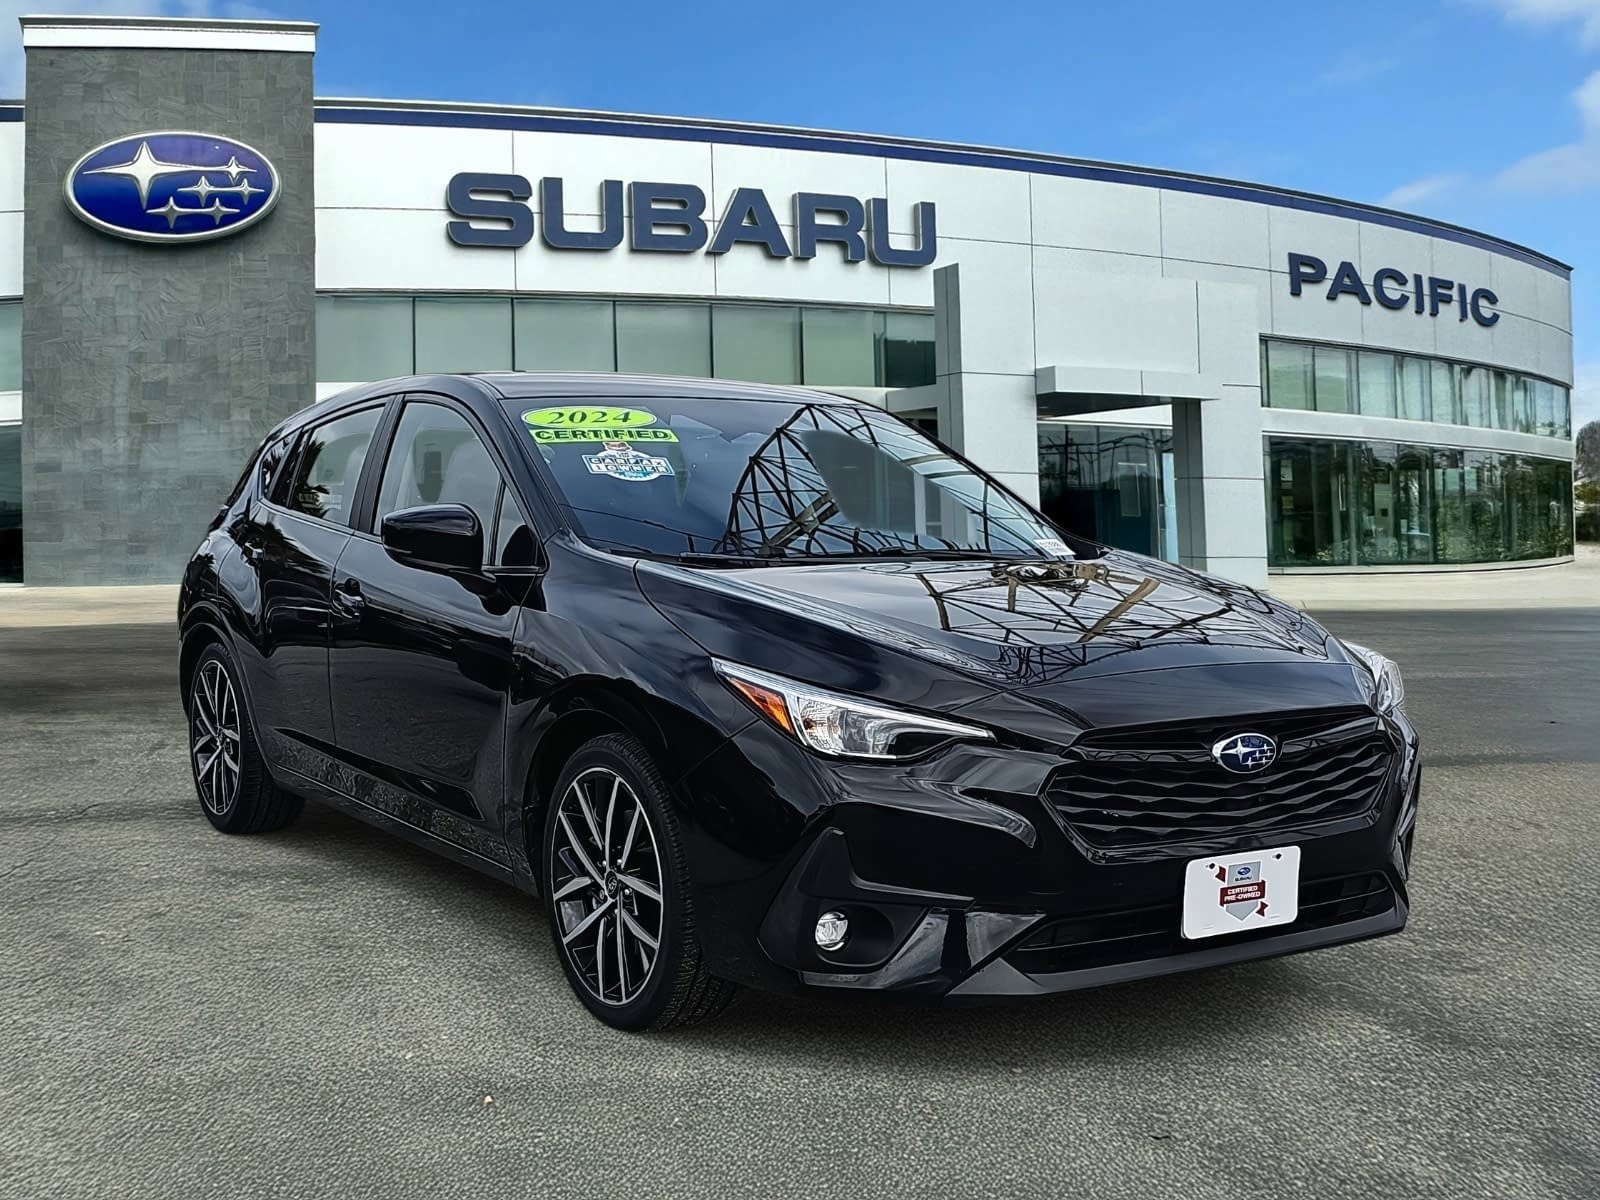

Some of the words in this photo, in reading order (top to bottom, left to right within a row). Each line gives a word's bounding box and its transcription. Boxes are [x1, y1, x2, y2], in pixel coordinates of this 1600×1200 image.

[446, 172, 937, 267] SUBARU
[1288, 252, 1500, 327] PACIFIC
[547, 410, 632, 425] 2024
[535, 429, 671, 440] CERTIFIED
[590, 457, 665, 466] CARFAX
[606, 465, 668, 473] OWNER
[1228, 886, 1258, 895] CERTIFIED
[1224, 892, 1261, 902] PRE-OWNED
